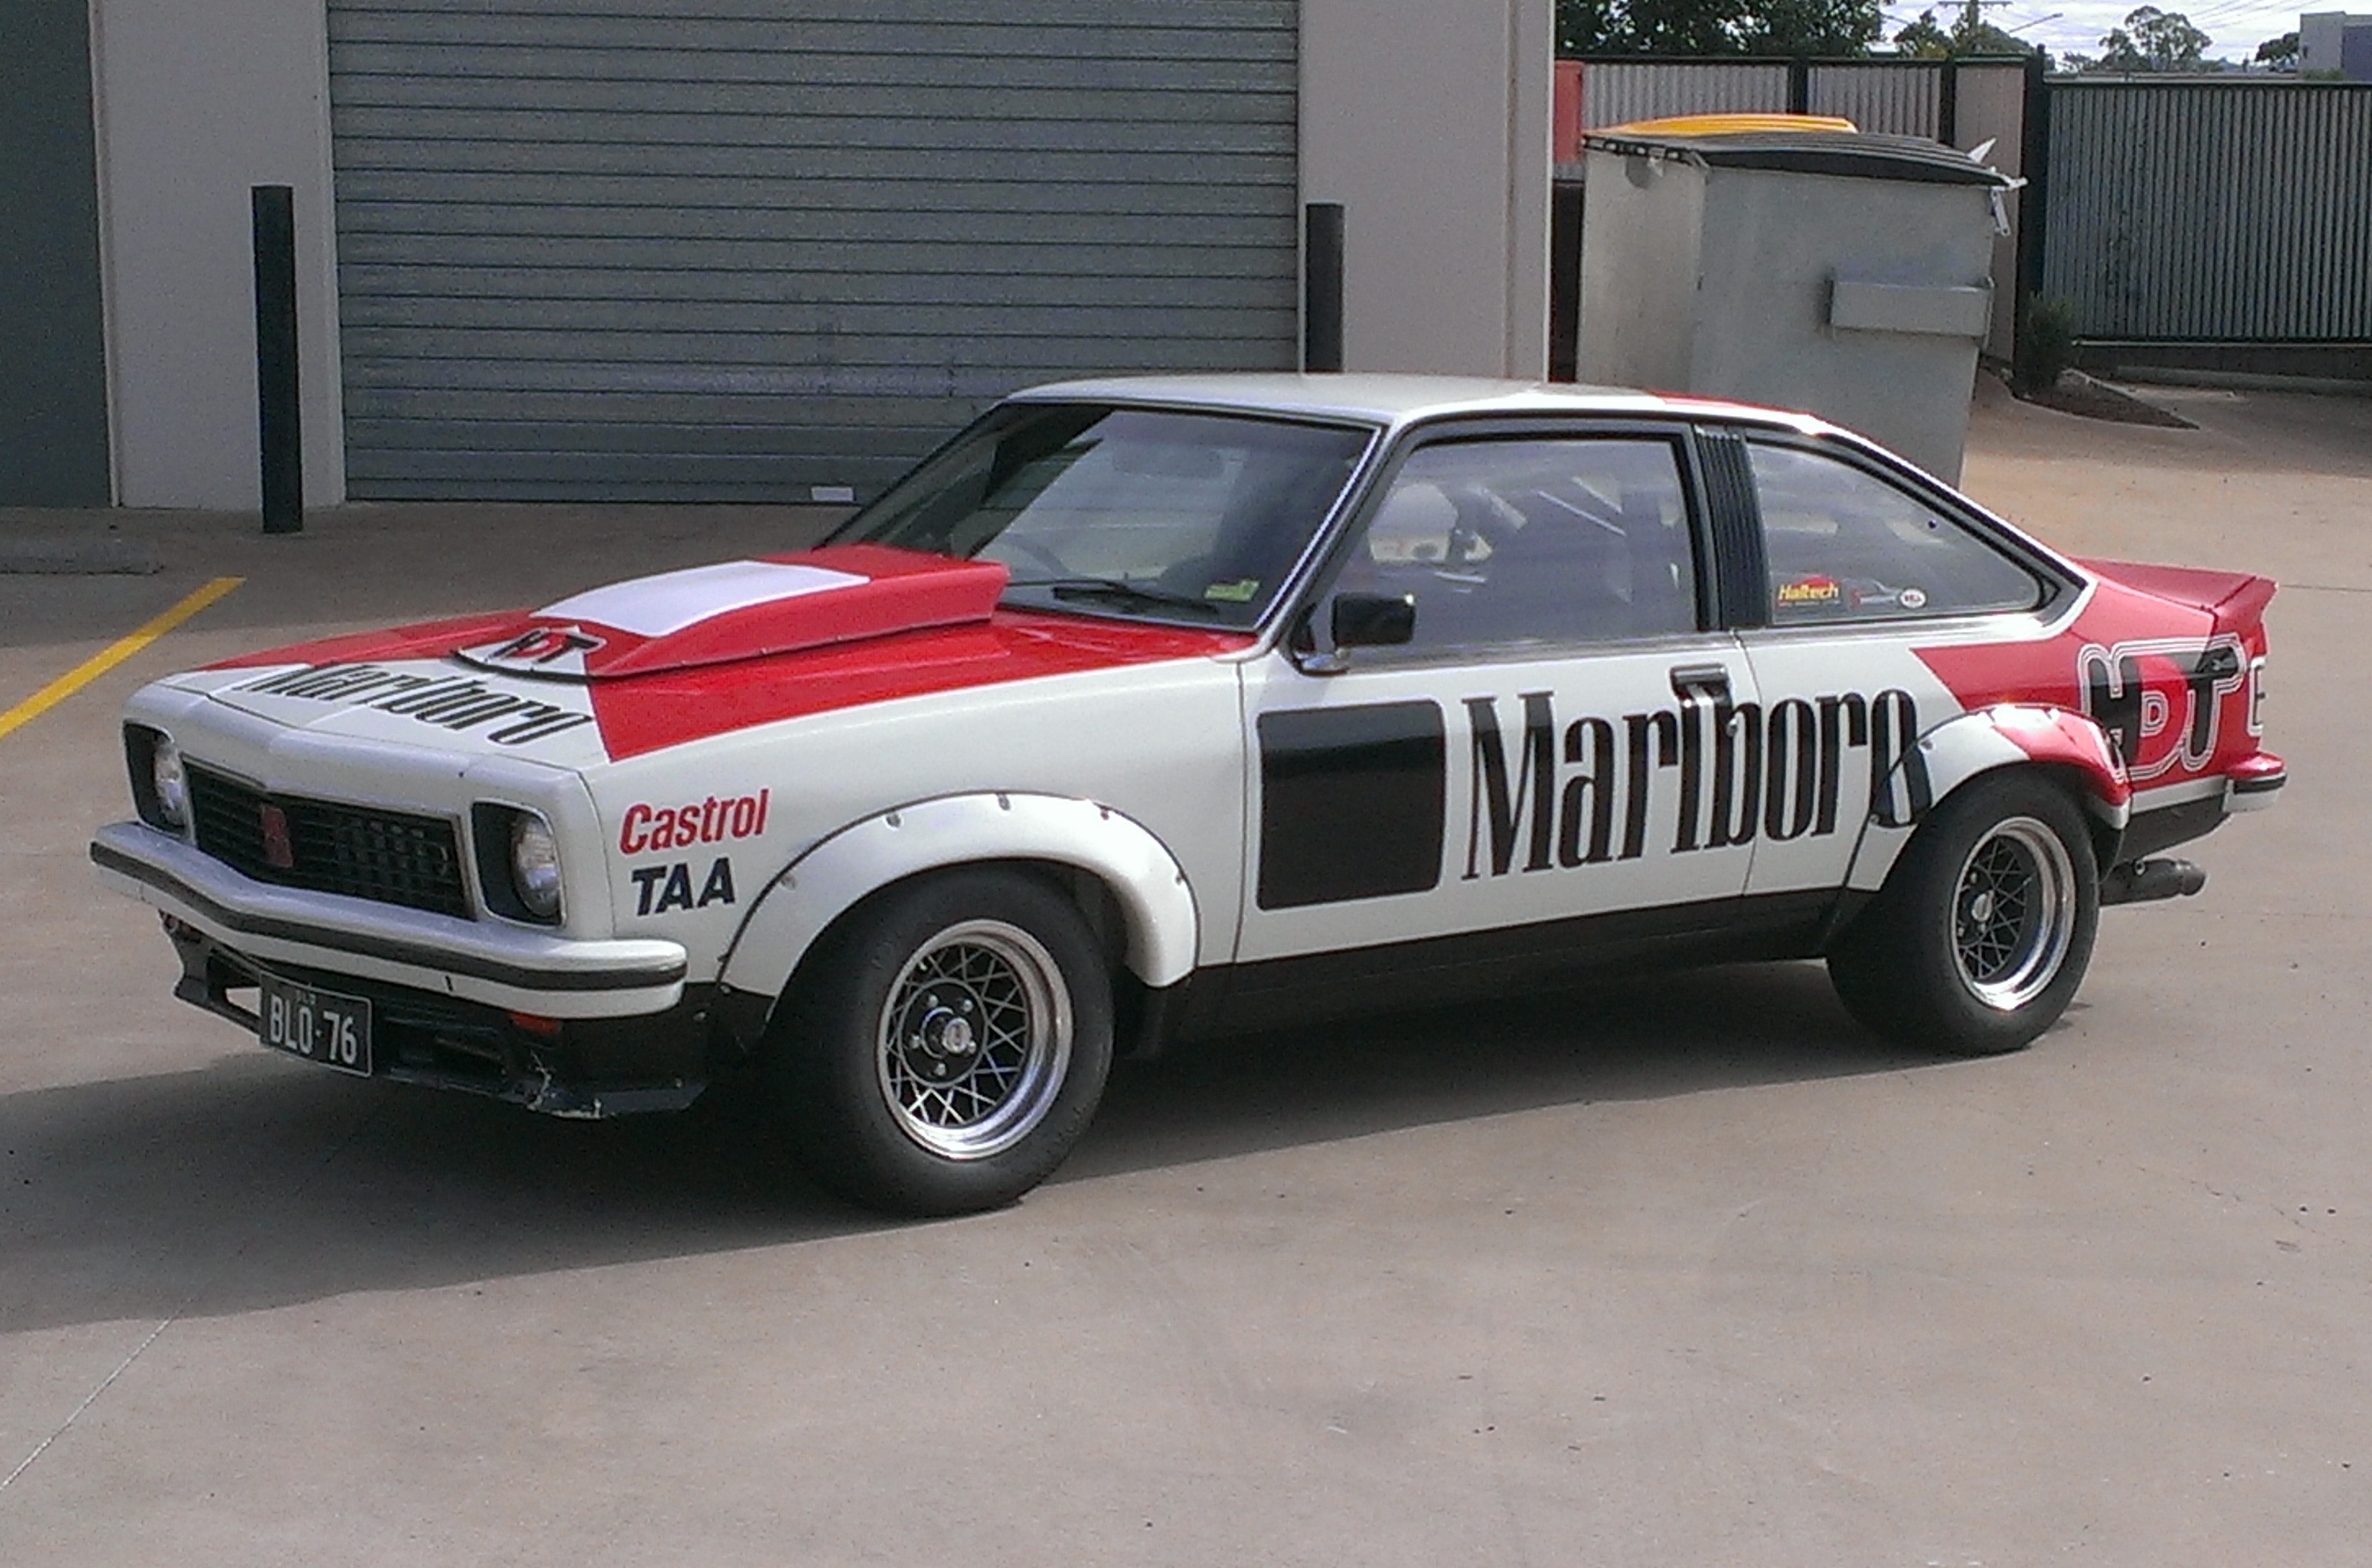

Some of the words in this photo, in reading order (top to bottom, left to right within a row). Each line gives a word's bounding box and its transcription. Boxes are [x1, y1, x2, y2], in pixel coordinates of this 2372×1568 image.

[231, 661, 594, 746] Marlboro
[2078, 632, 2248, 781] HDT
[619, 788, 769, 855] Castrol
[1461, 688, 1933, 881] Marlboro
[632, 857, 736, 917] TAA
